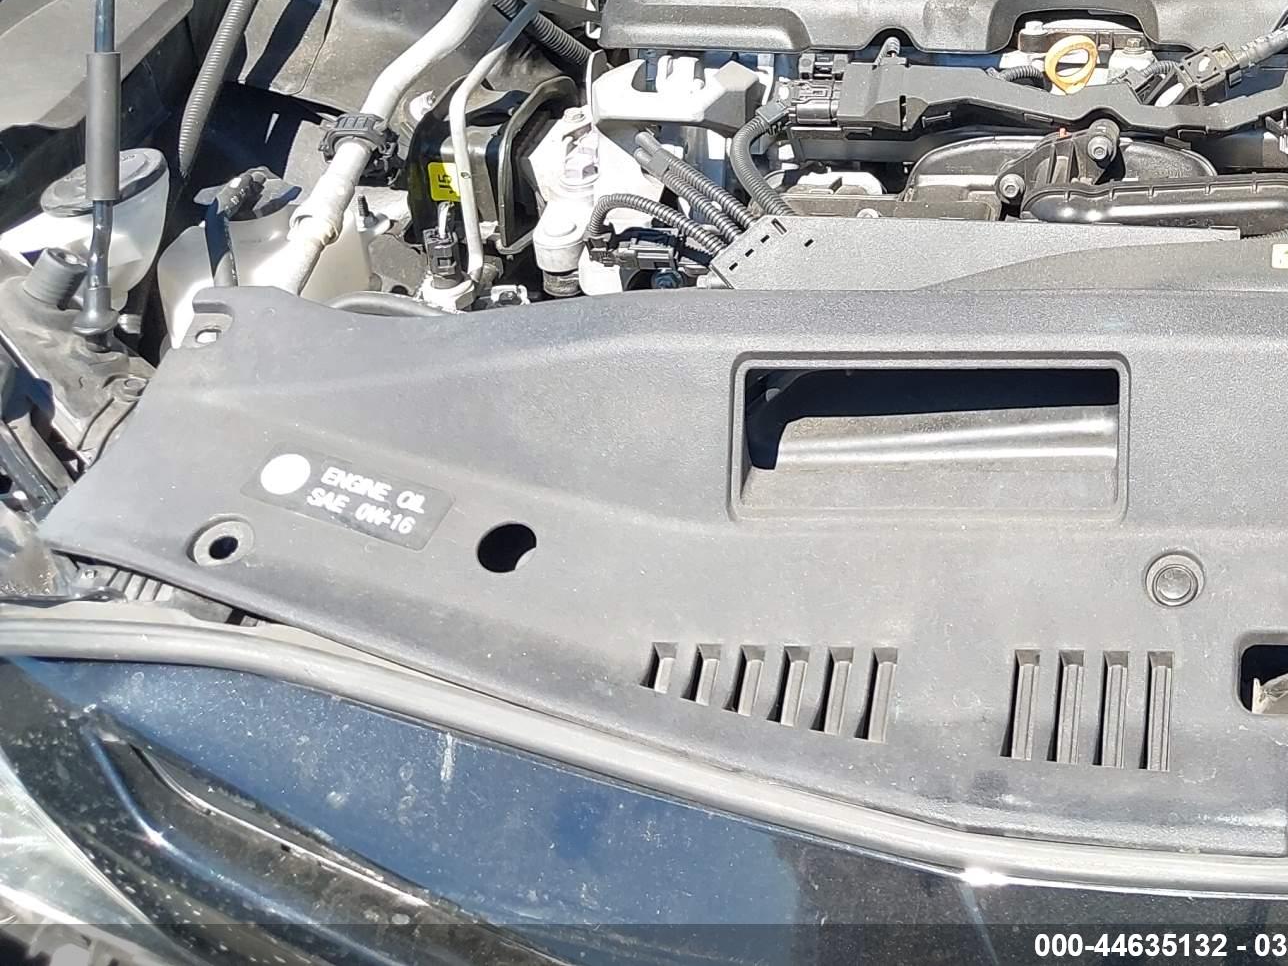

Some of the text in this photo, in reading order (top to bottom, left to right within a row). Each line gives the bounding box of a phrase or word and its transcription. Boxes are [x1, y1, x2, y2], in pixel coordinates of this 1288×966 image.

[306, 487, 416, 534] SAE 0W-16
[321, 466, 425, 514] ENGINE OIL
